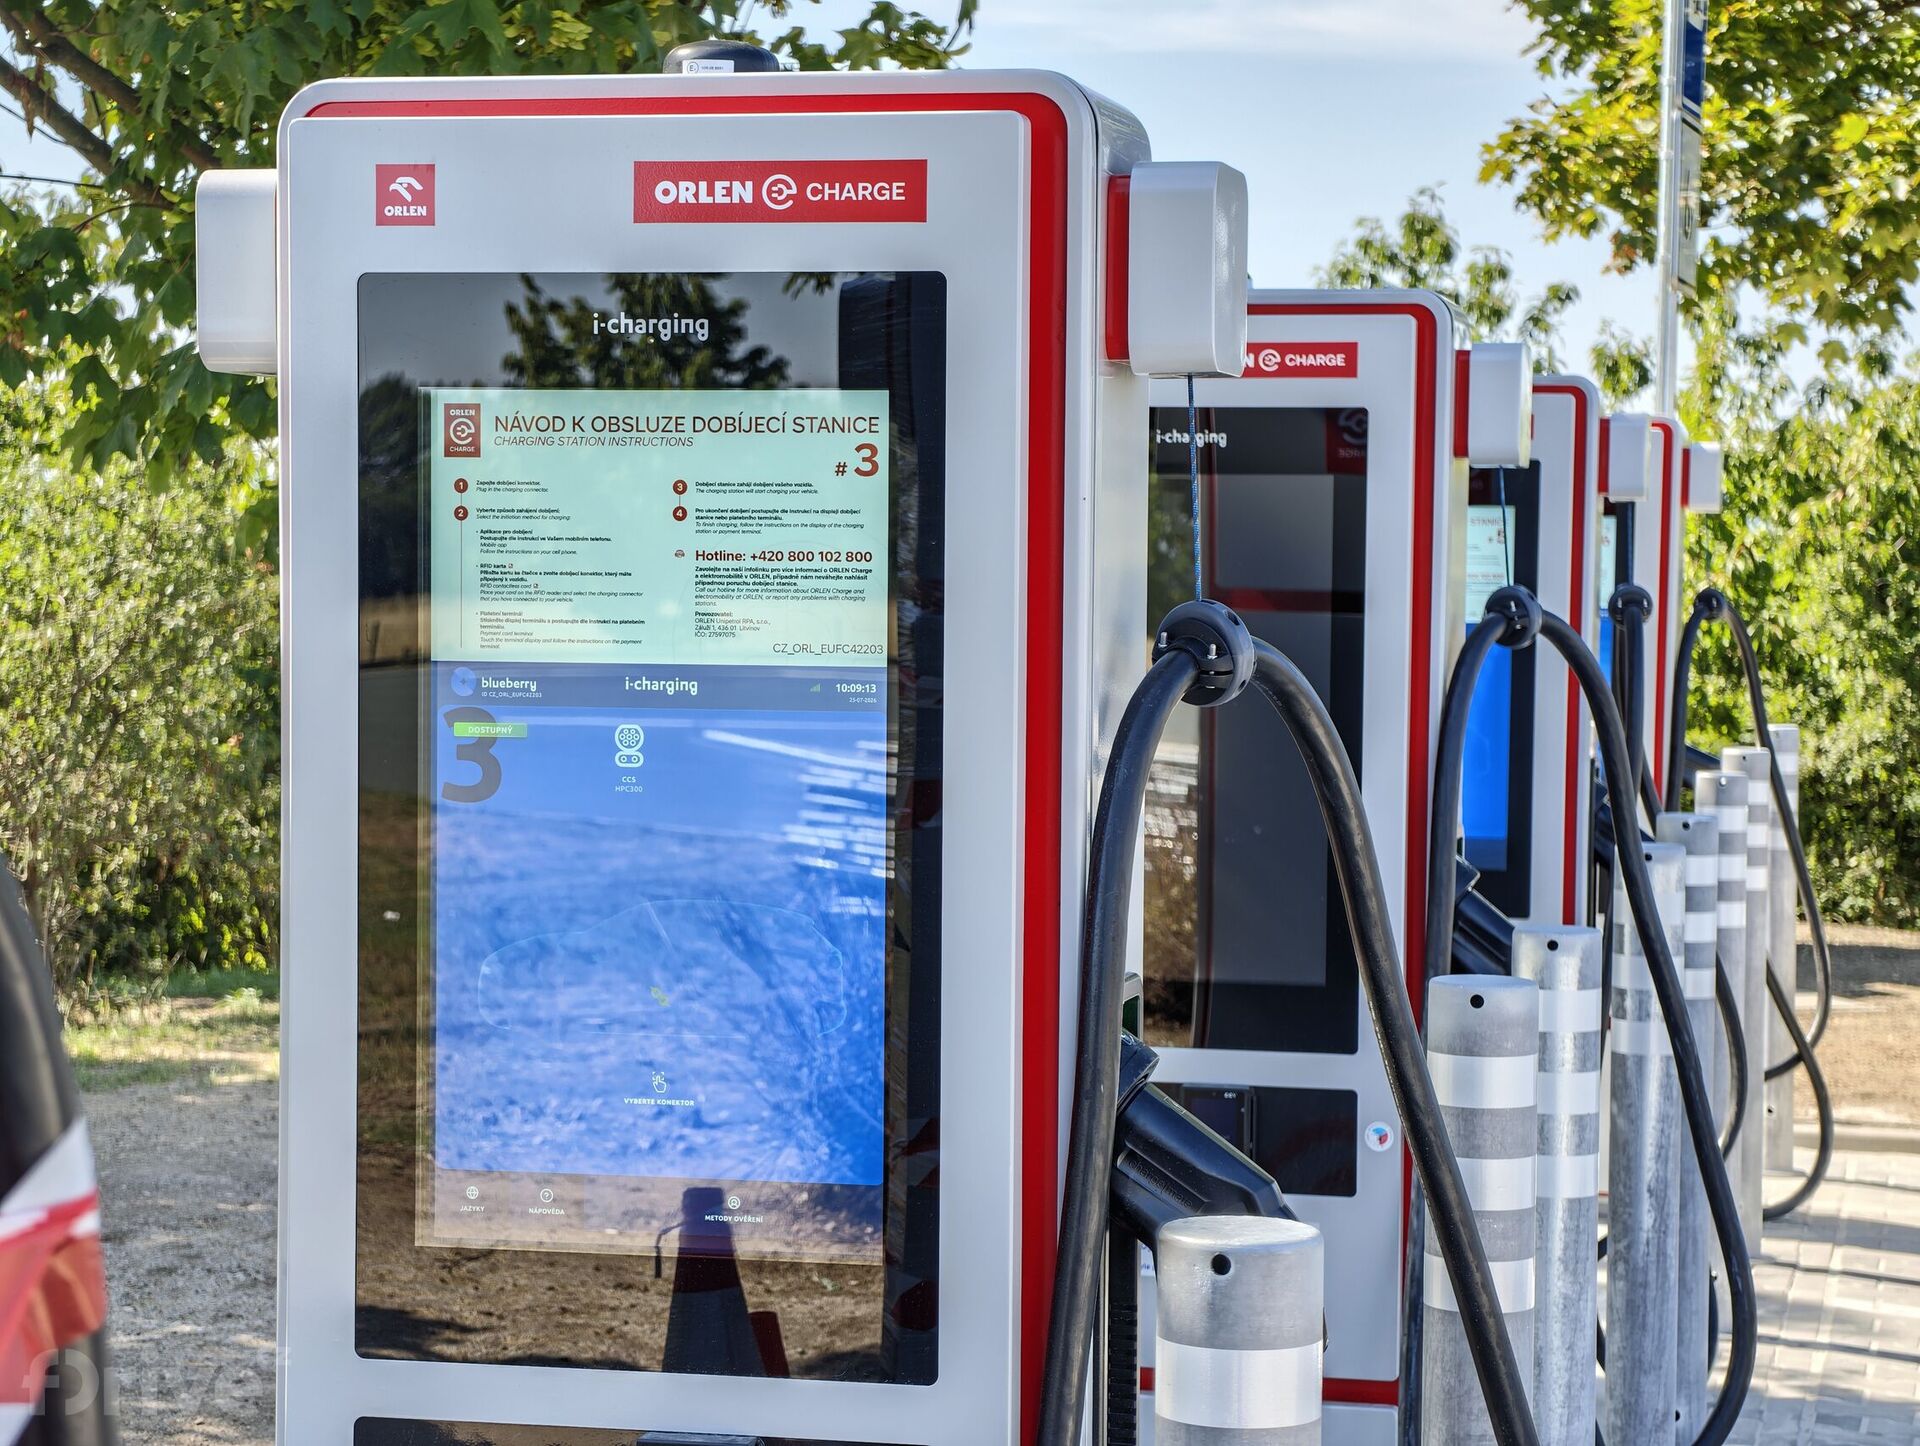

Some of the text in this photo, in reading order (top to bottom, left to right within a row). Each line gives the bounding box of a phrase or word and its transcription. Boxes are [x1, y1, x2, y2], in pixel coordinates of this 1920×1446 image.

[655, 180, 906, 204] ORLEN CHARGE
[384, 206, 427, 216] ORLEN
[593, 312, 709, 342] i-charging
[1284, 354, 1346, 367] CHARGE
[495, 411, 879, 433] NÁVOD K OBSLUZE DOBÍJECÍ STANICE
[494, 436, 694, 447] CHARGING STATION INSTRUCTIONS
[1156, 429, 1227, 448] i-chaging
[695, 550, 872, 562] Hotline: +420 800 102 800
[773, 644, 884, 655] CZ_ORL_EUFC42203
[482, 677, 536, 691] blueberry
[625, 676, 698, 696] i-charging
[836, 683, 876, 693] 10:09:13
[468, 725, 513, 734] DOSTUPNÝ
[442, 707, 502, 803] 3
